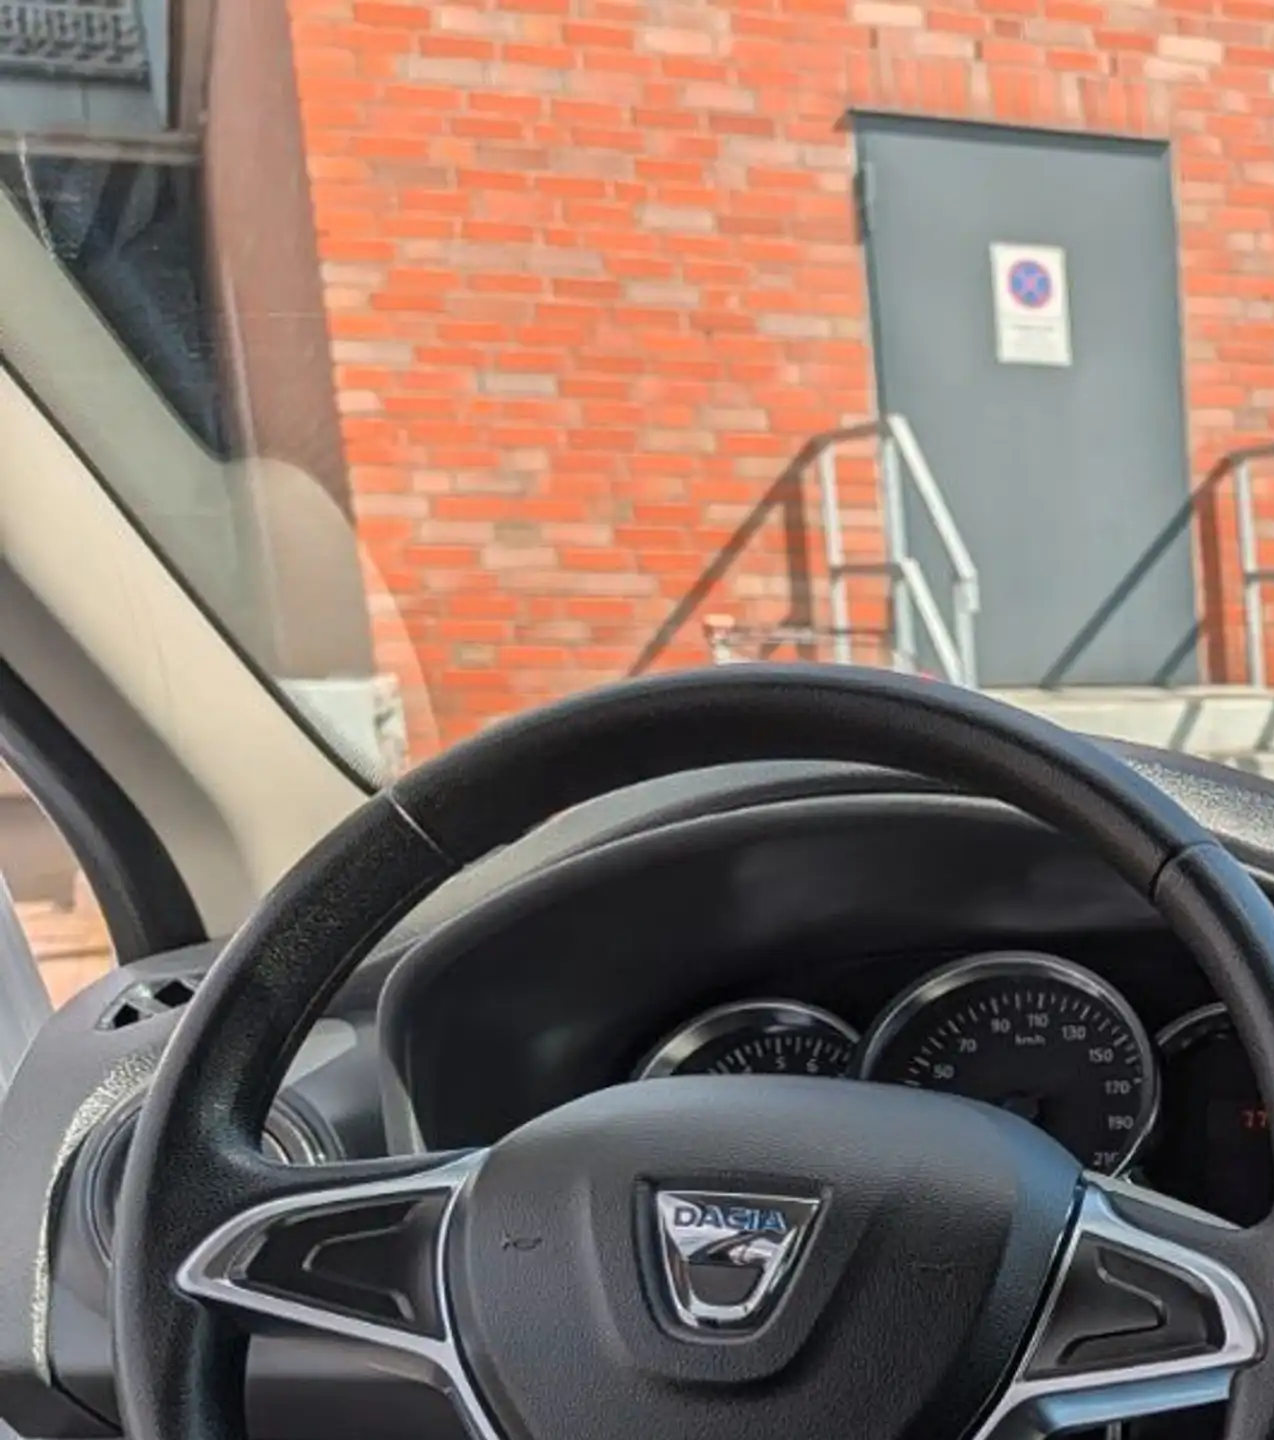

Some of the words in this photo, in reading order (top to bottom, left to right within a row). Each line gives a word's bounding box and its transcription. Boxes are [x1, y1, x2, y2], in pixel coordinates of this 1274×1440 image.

[1061, 1025, 1087, 1041] 130
[1089, 1048, 1115, 1063] 150
[673, 1204, 788, 1232] DACIA
